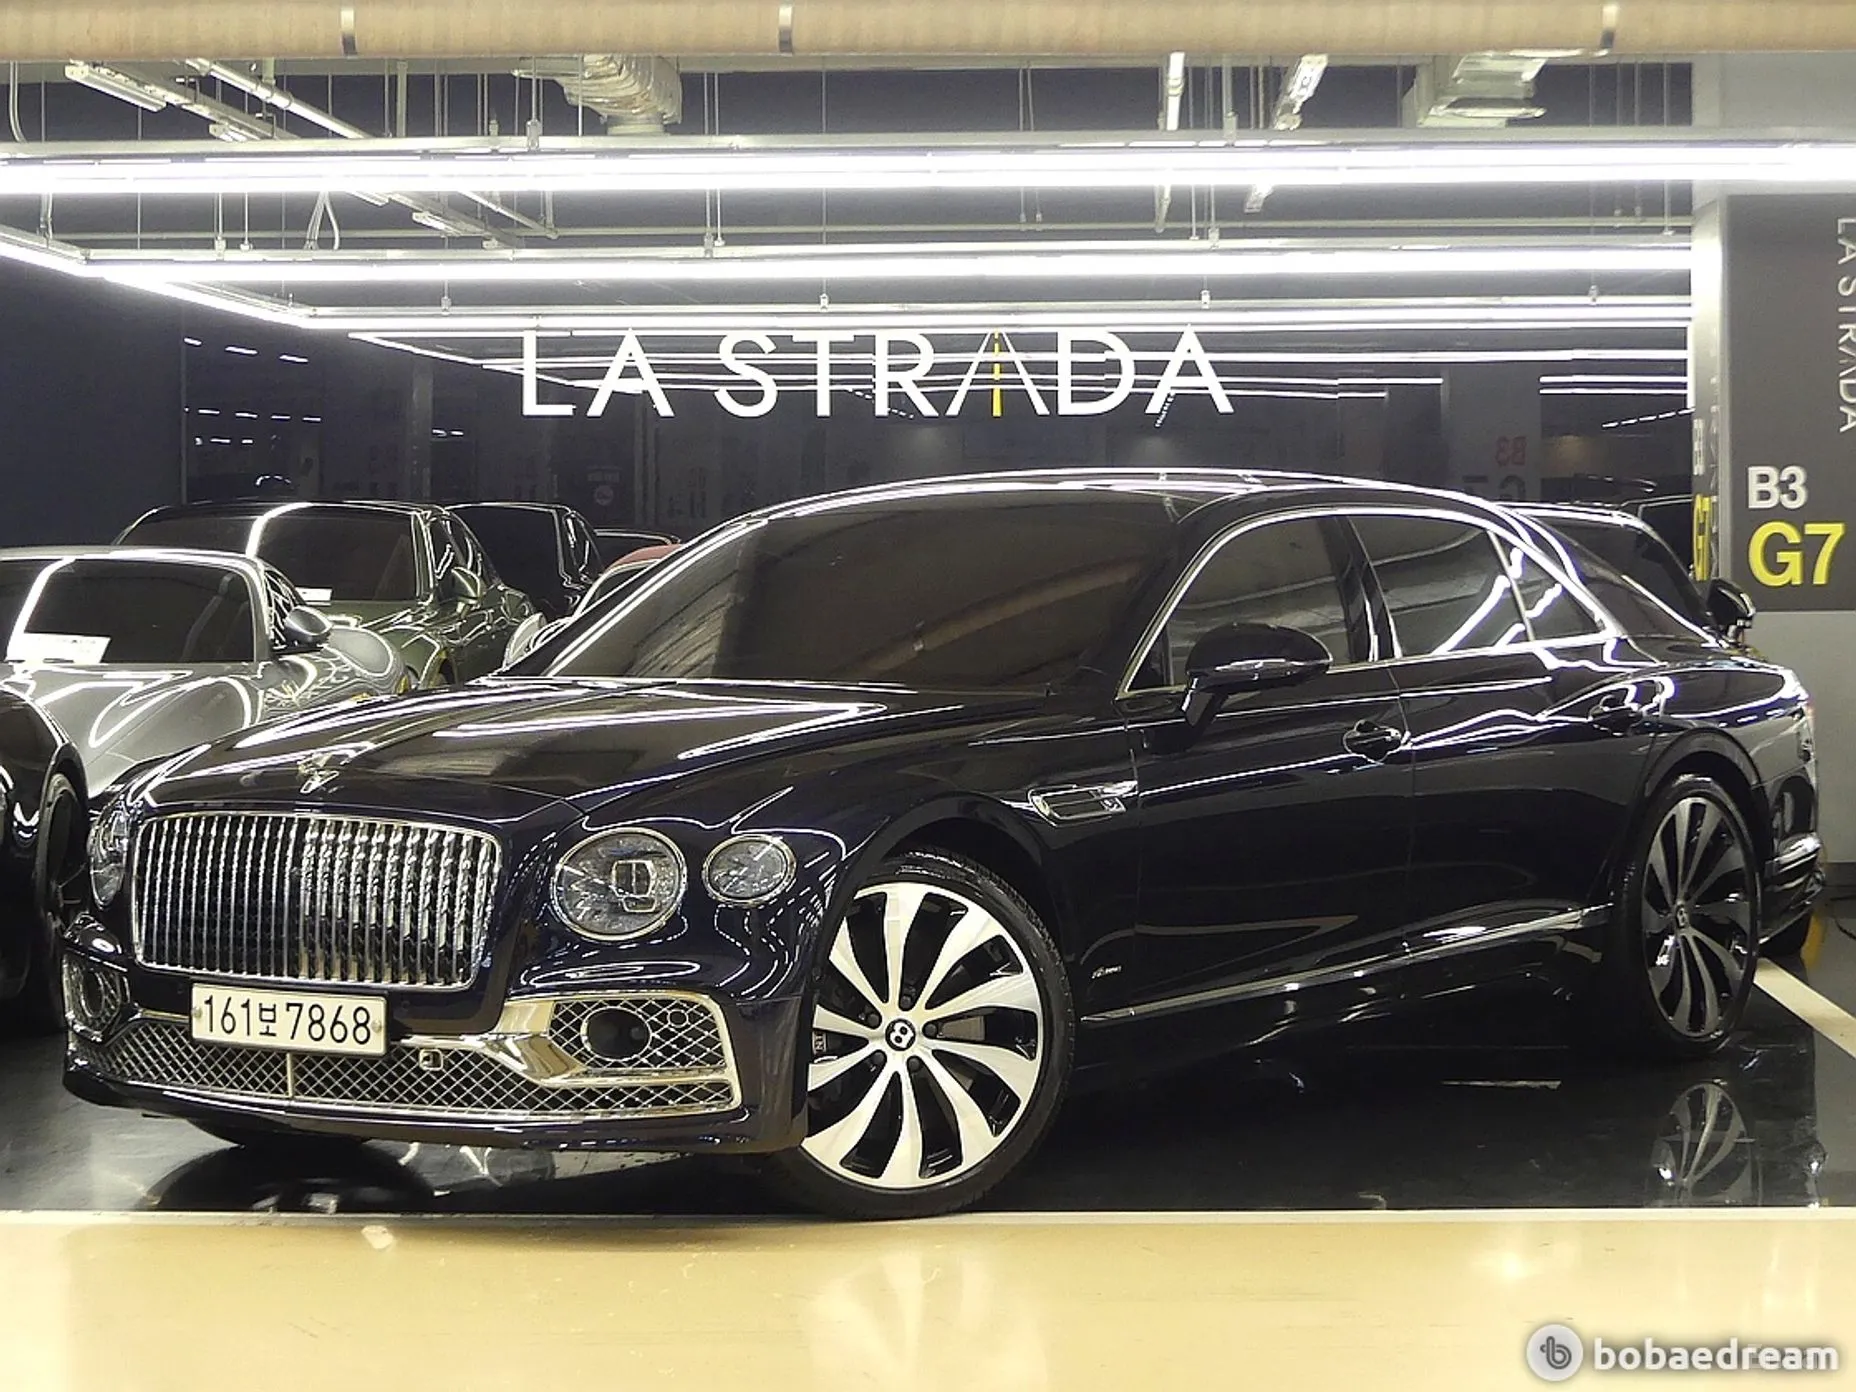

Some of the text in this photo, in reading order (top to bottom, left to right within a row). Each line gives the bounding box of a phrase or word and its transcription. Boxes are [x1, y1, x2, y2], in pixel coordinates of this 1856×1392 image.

[522, 325, 1236, 418] LA STRADA
[1747, 465, 1808, 510] B3
[1747, 520, 1846, 588] G7
